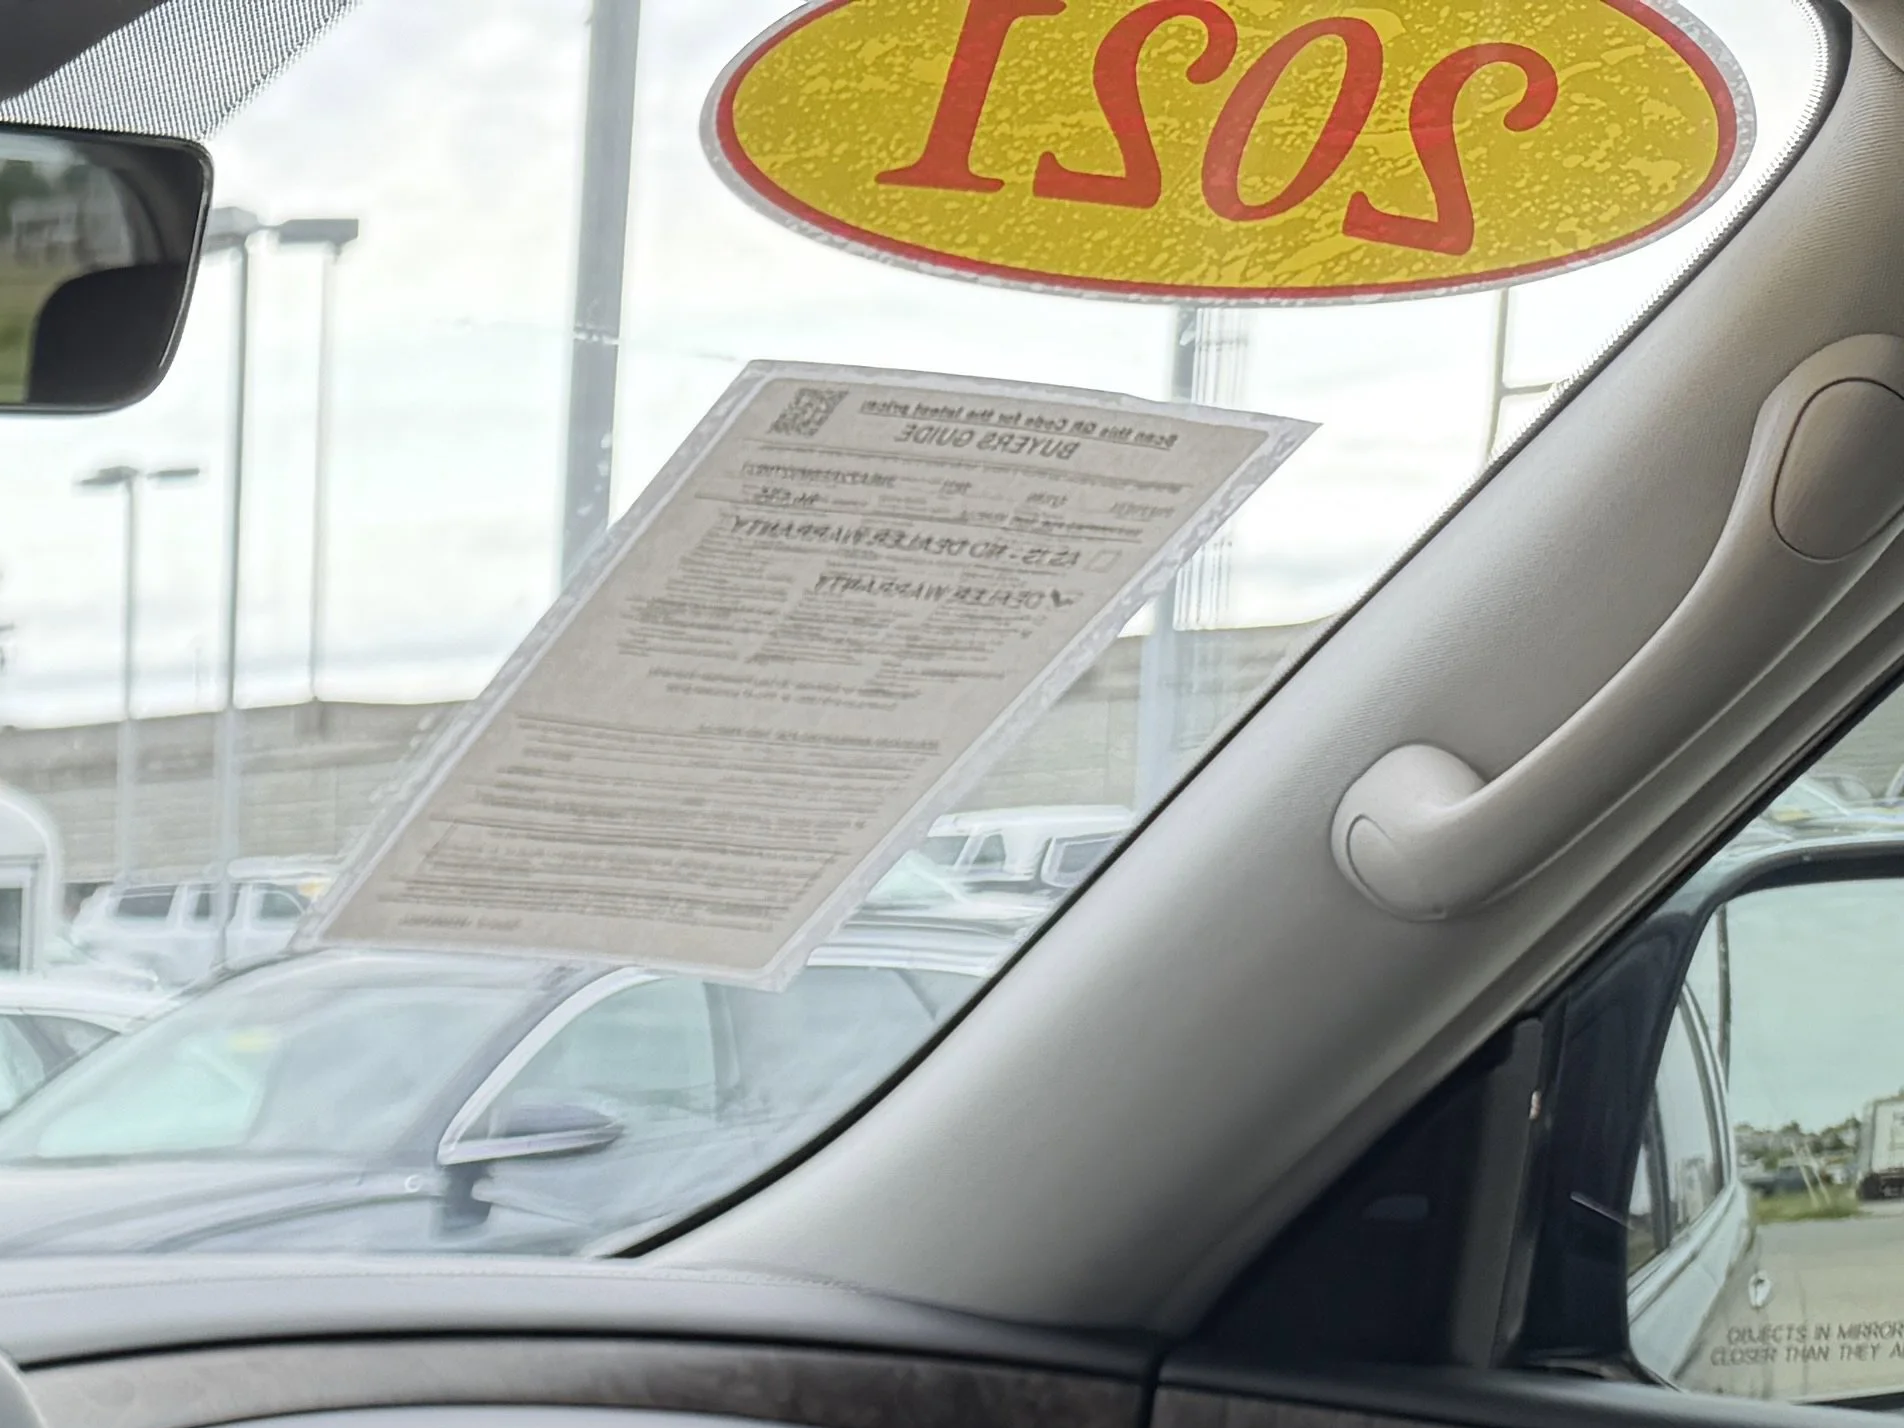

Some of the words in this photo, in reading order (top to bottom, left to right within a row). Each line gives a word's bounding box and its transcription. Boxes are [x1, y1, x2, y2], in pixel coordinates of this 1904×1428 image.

[1727, 1324, 1807, 1345] OBJECTS
[1814, 1323, 1830, 1341] IN
[1710, 1345, 1778, 1367] CLOSER
[1784, 1344, 1830, 1362] THAN
[1839, 1342, 1881, 1361] THEY
